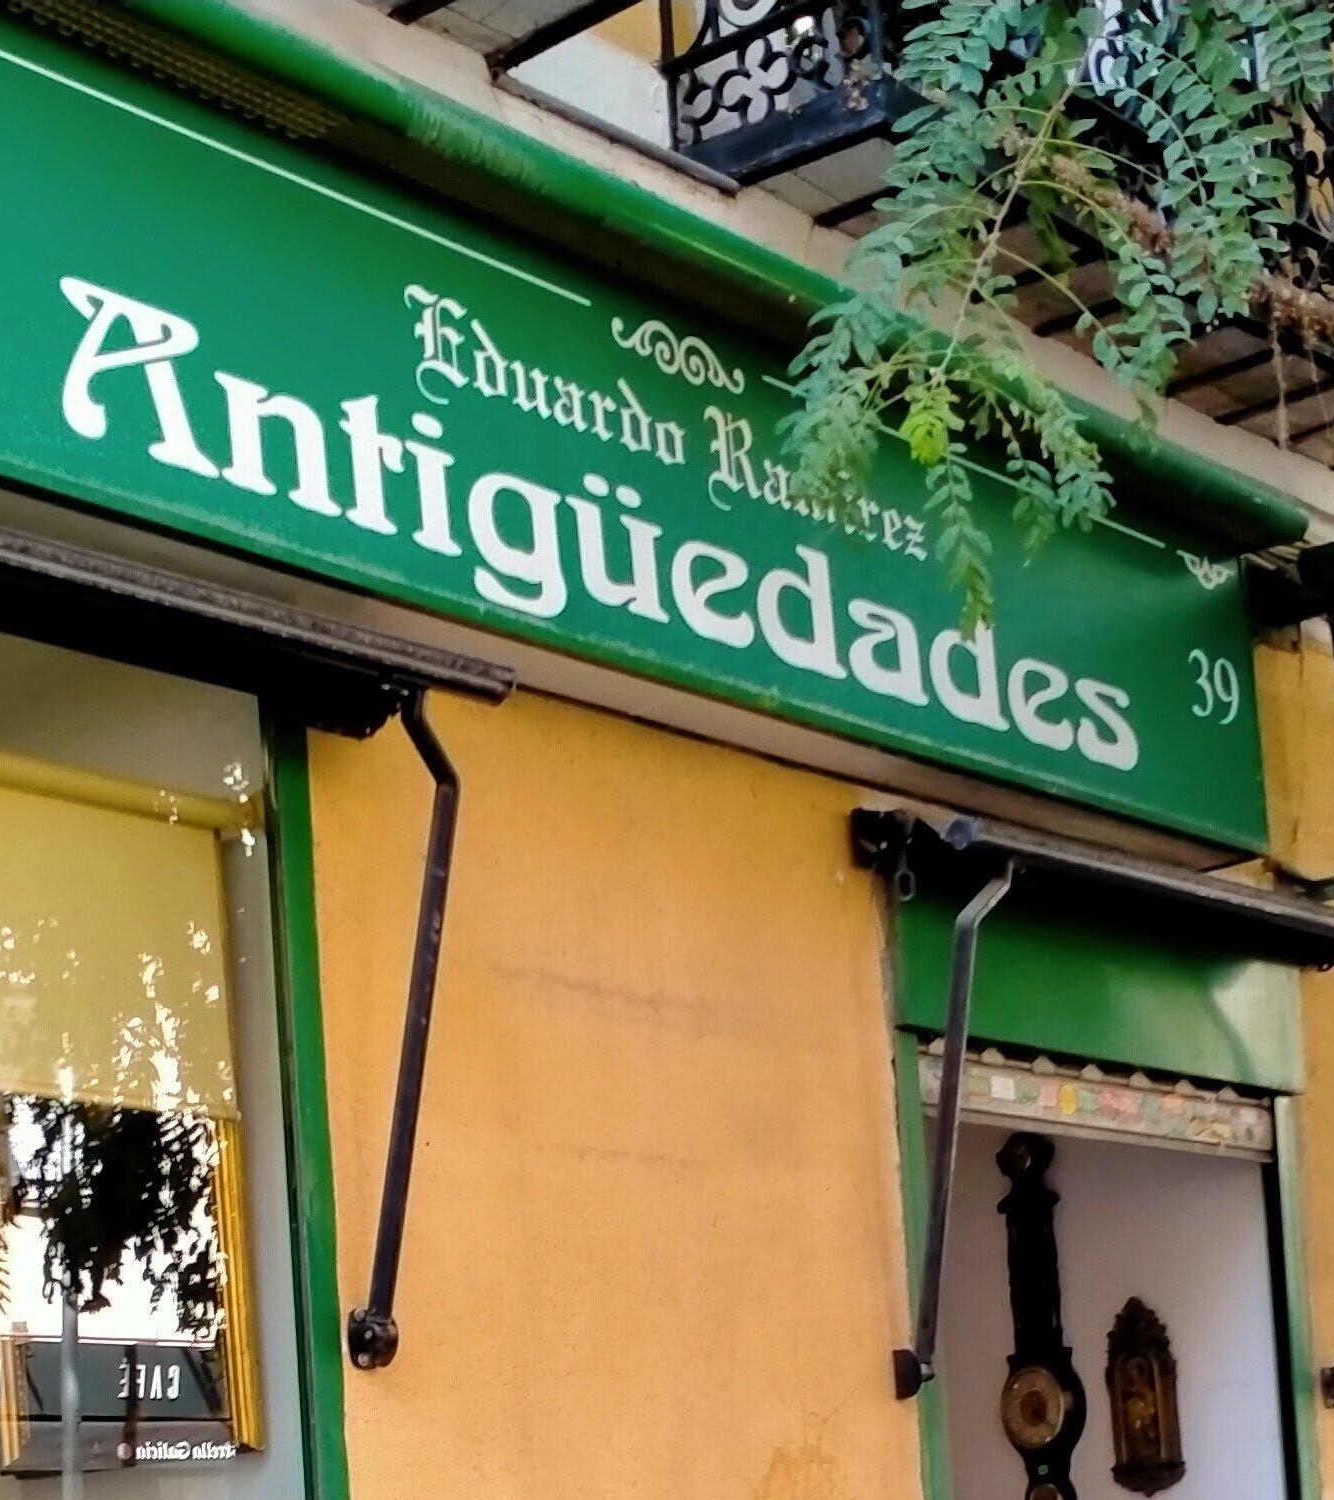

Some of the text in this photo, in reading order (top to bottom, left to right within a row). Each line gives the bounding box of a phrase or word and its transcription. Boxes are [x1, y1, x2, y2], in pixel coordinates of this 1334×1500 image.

[60, 276, 1139, 772] Antigüedades
[403, 283, 929, 562] Eduardo Rarez
[1187, 647, 1240, 726] 39
